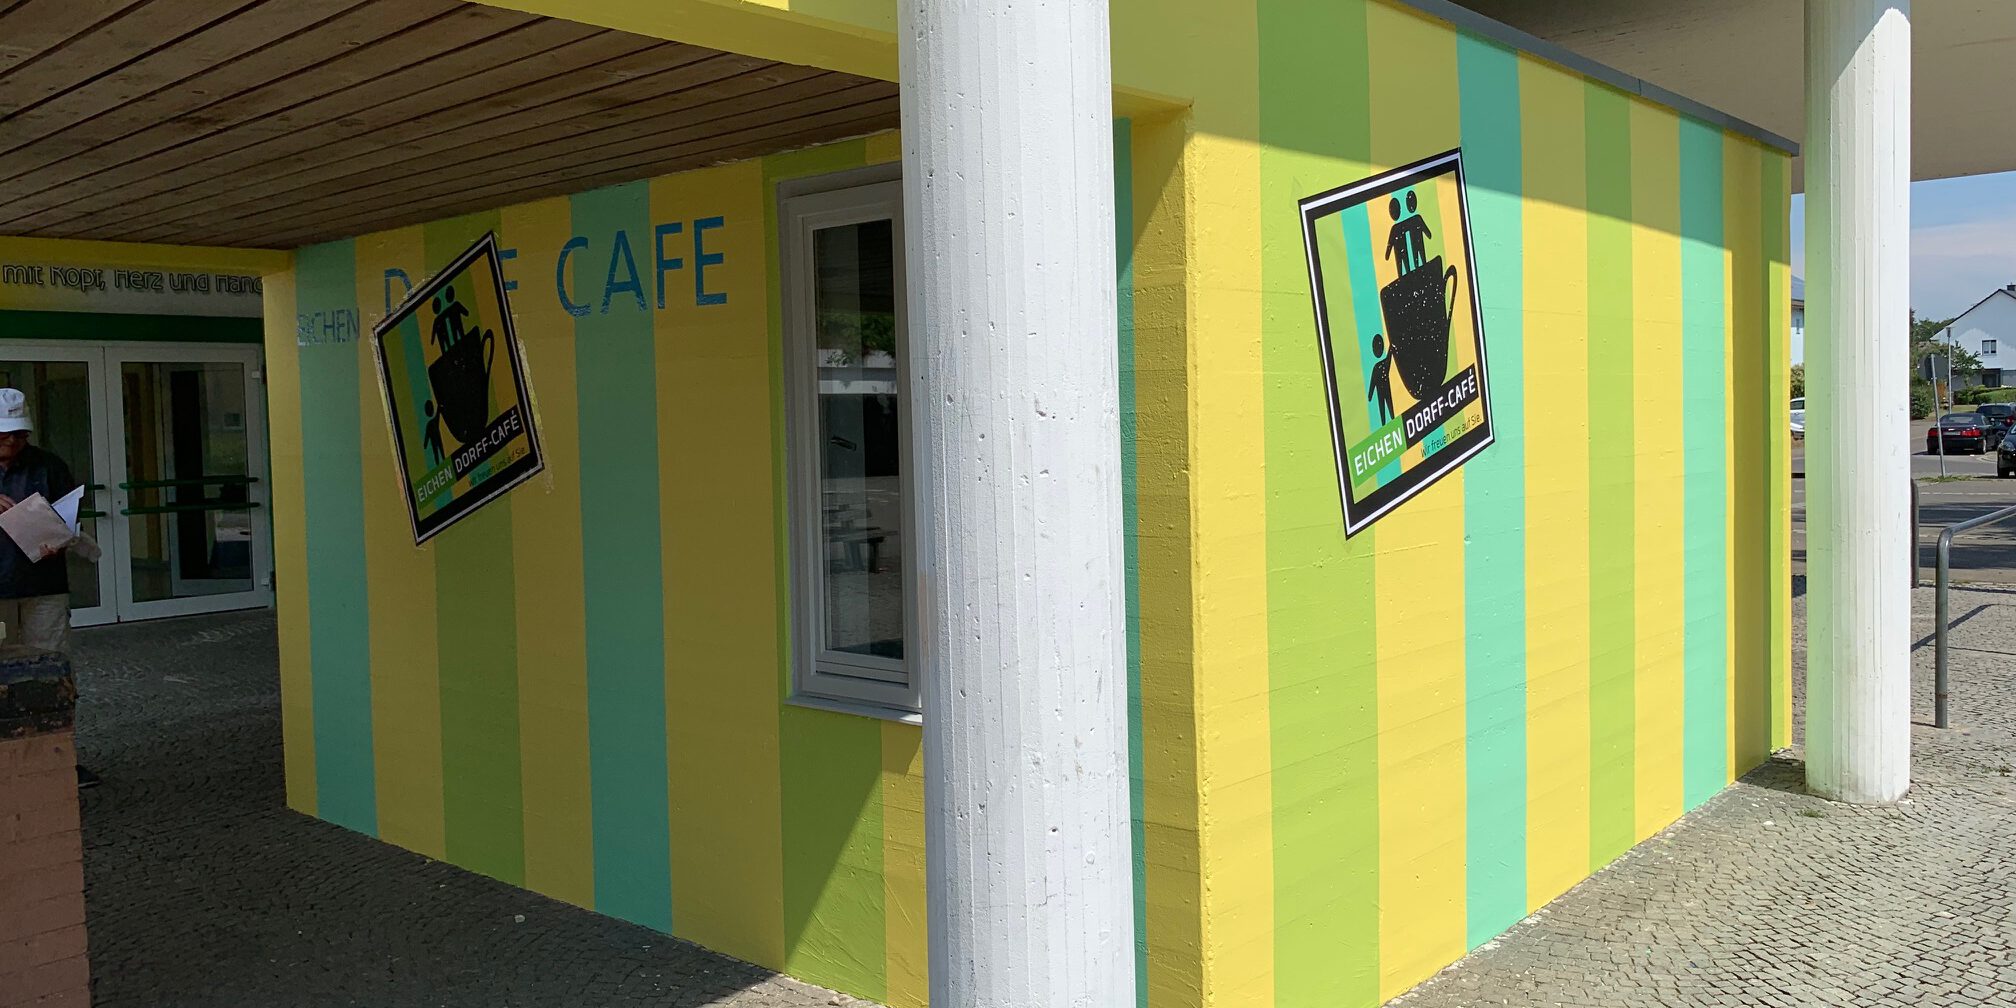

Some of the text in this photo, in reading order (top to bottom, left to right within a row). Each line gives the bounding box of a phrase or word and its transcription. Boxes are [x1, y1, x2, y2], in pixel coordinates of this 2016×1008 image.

[3, 264, 44, 285] mit
[114, 268, 163, 291] Herz
[169, 272, 209, 292] und
[556, 216, 728, 317] CAFE
[418, 466, 453, 502] EICHEN
[455, 410, 520, 472] DORFF-CAFÉ
[1354, 368, 1476, 476] EICHEN DORFF-CAFÉ
[1431, 433, 1450, 452] freuen
[1450, 427, 1461, 439] uns
[1462, 417, 1471, 432] auf
